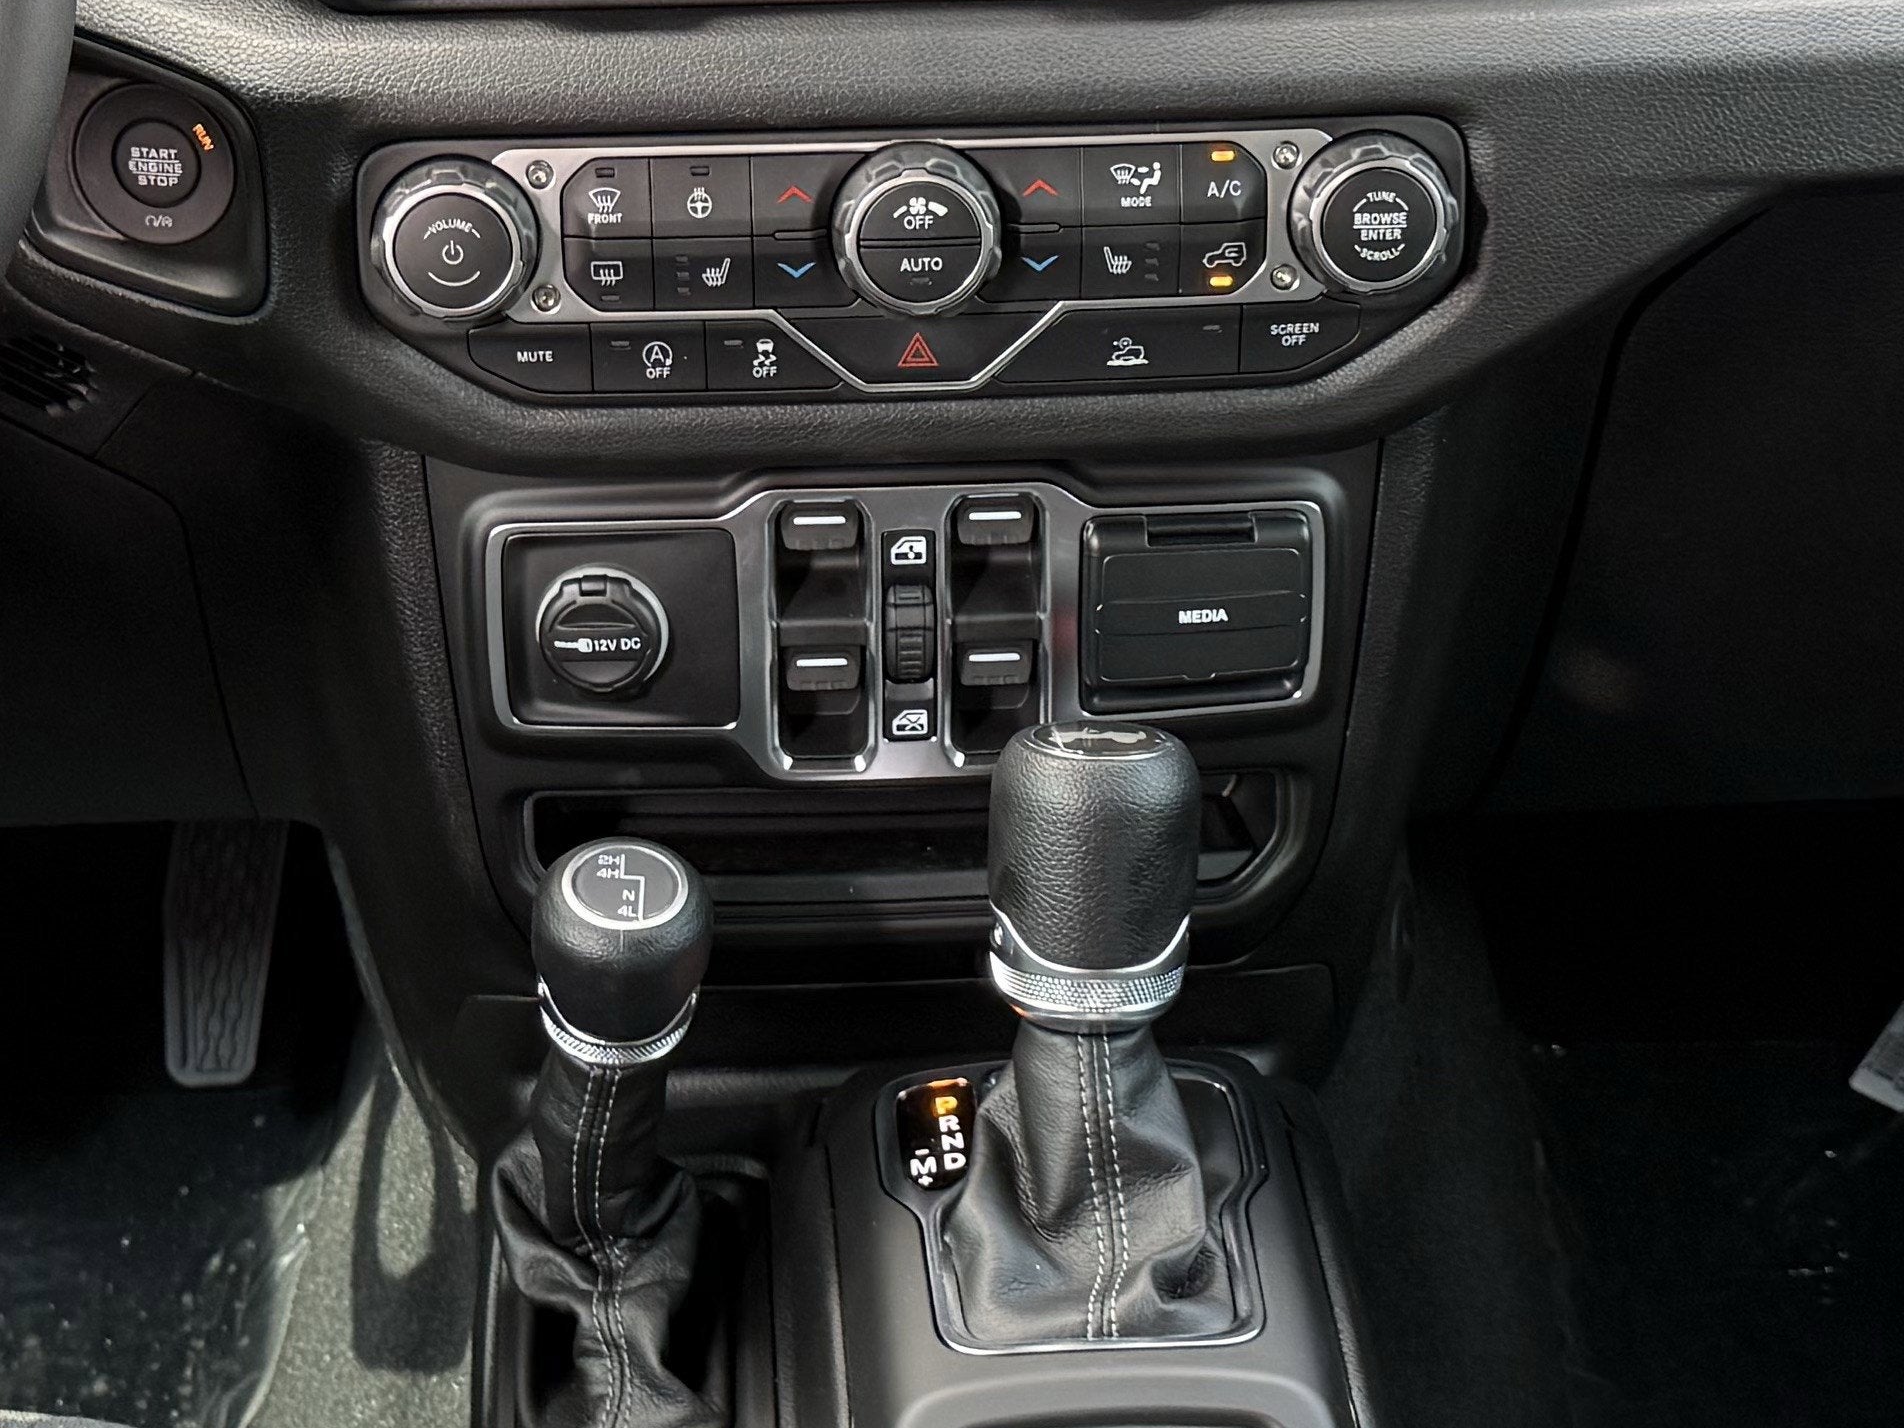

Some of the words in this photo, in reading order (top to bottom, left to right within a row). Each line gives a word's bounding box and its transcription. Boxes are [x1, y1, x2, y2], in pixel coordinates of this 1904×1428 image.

[192, 122, 215, 151] RUN
[130, 146, 178, 159] START
[128, 159, 183, 174] ENGINE
[137, 174, 179, 187] STOP
[1206, 180, 1243, 198] A/C
[1120, 196, 1152, 208] MODE
[1366, 190, 1397, 204] TUNE
[587, 212, 623, 225] FRONT
[903, 215, 934, 231] OFF
[1353, 212, 1408, 227] BROWSE
[427, 218, 474, 235] VOLUME
[1359, 228, 1402, 242] ENTER
[1359, 247, 1401, 262] SCROLL
[900, 256, 944, 272] AUTO
[1269, 322, 1320, 336] SCREEN
[1280, 334, 1308, 348] OFF
[516, 350, 554, 363] MUTE
[645, 367, 672, 380] OFF
[752, 366, 778, 379] OFF
[1178, 608, 1229, 624] MEDIA
[593, 638, 617, 652] 12V
[620, 637, 642, 651] DC
[597, 854, 620, 866] 2H
[596, 867, 620, 879] 4H
[621, 889, 636, 902] N
[617, 904, 637, 918] 4L
[935, 1095, 958, 1115] P
[938, 1114, 961, 1133] R
[940, 1132, 965, 1152] N
[909, 1156, 937, 1177] M
[943, 1152, 967, 1171] D
